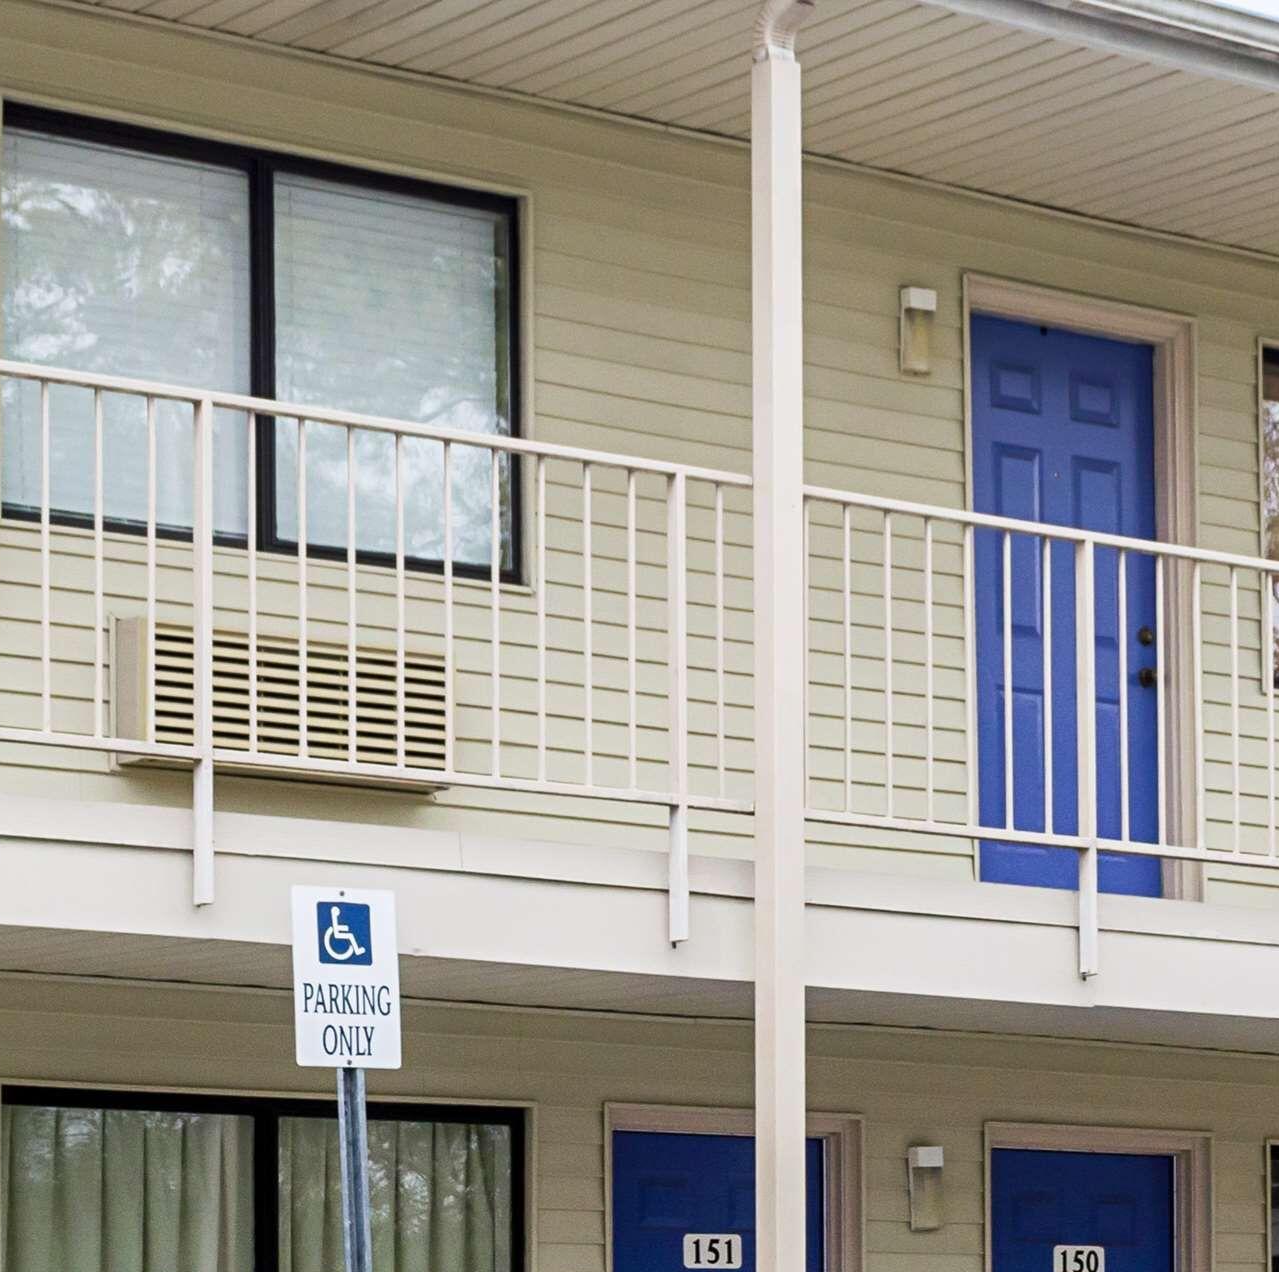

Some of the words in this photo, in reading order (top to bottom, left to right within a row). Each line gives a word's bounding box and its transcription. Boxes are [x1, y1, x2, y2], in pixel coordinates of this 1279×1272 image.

[303, 983, 392, 1016] PARKING
[322, 1024, 375, 1057] ONLY
[692, 1238, 734, 1264] 151
